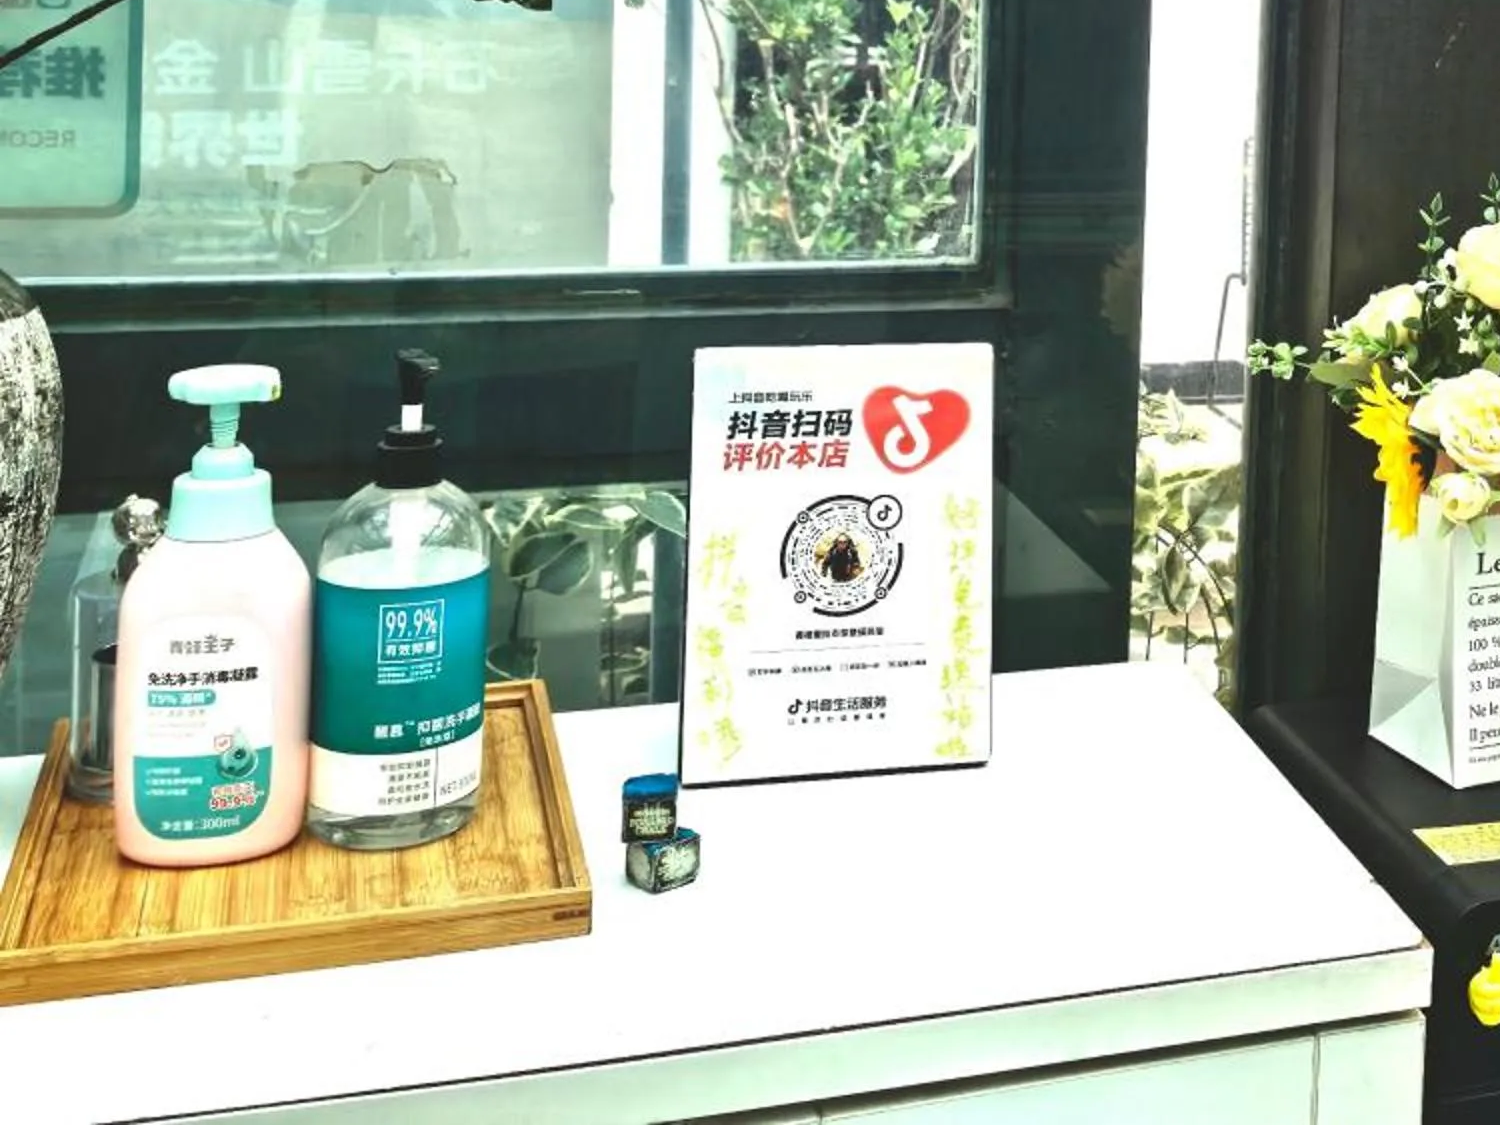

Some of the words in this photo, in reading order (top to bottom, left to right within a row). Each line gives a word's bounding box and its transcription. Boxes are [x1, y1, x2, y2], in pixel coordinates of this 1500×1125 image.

[727, 408, 854, 440] 抖音扫码
[723, 439, 851, 472] 评价本店
[1468, 592, 1485, 606] Ce
[385, 607, 438, 637] 99.9%
[1468, 638, 1489, 651] 100
[147, 666, 259, 687] 免洗净手消毒凝露
[805, 696, 888, 713] 抖音生活服务
[1469, 704, 1487, 719] Ne
